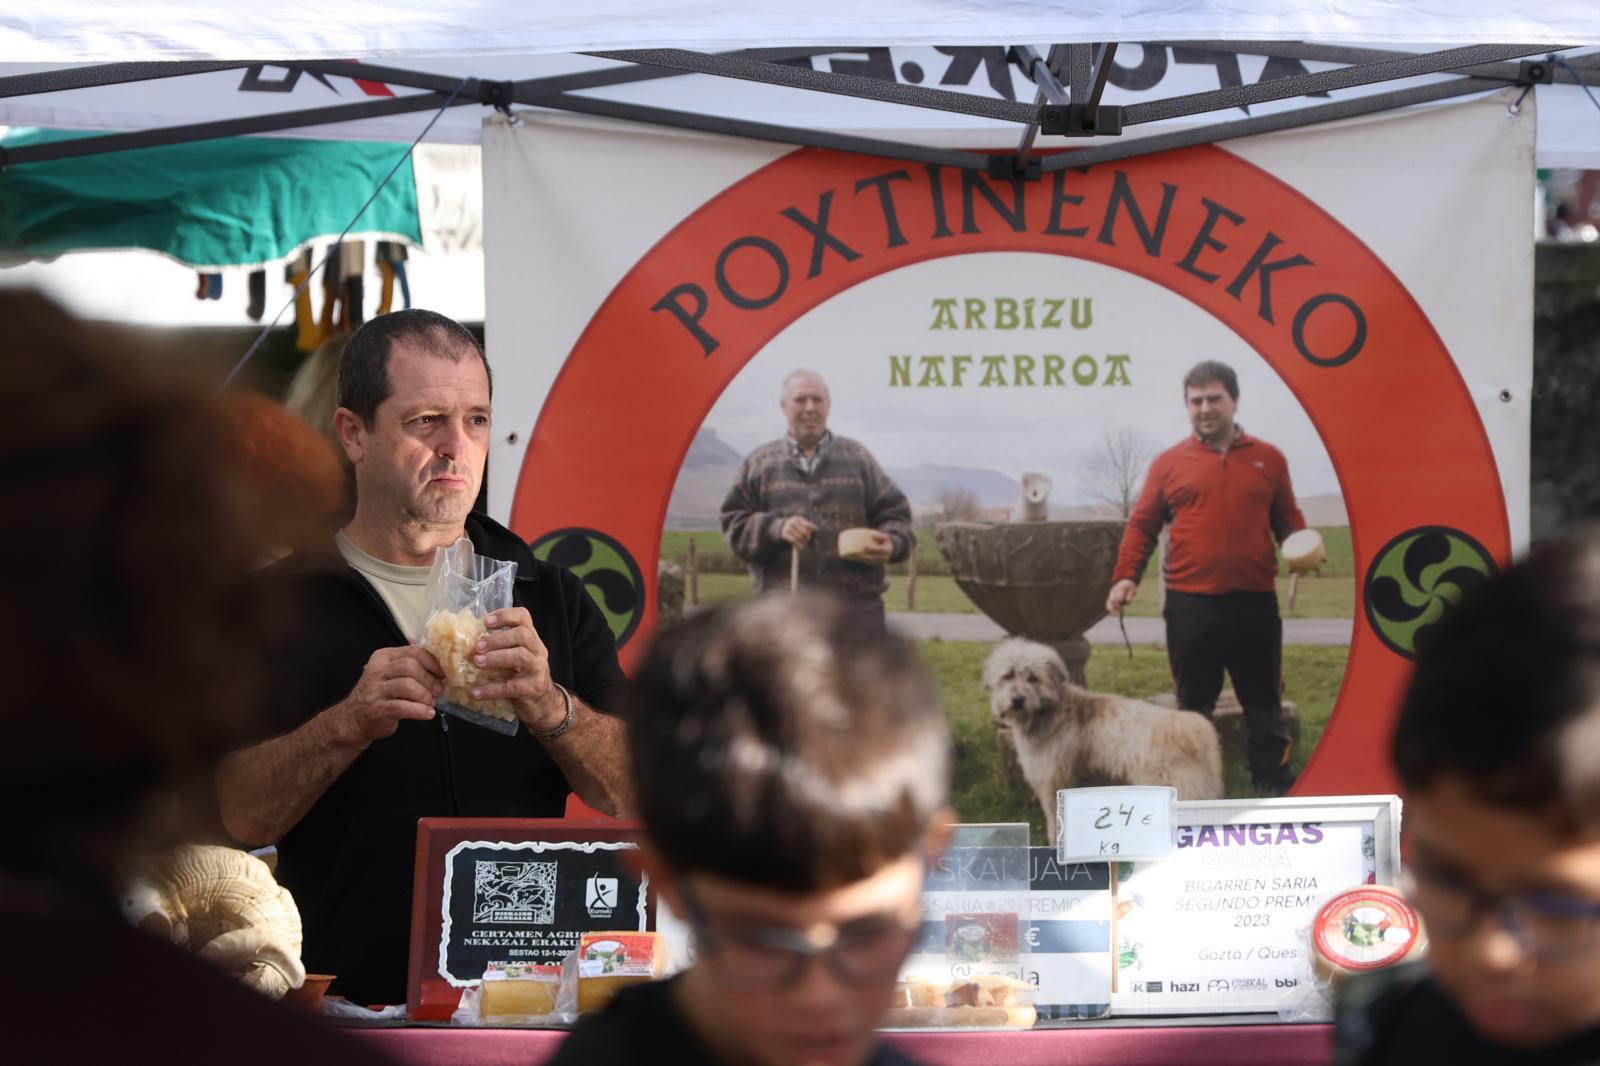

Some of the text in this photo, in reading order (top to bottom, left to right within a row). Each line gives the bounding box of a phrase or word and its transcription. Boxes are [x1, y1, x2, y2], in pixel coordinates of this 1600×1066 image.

[650, 163, 1368, 368] POXTINENEKO
[889, 354, 1133, 388] NAFARROA
[1094, 803, 1135, 830] 24
[927, 856, 1013, 881] SKAL
[1185, 877, 1318, 893] BIGARREN SARIA
[932, 898, 984, 912] SARIA
[1175, 897, 1260, 911] SEGUNDO
[1234, 914, 1271, 928] 2023
[472, 930, 543, 938] CERTAMEN
[464, 938, 528, 946] NEKAZAL
[1198, 949, 1242, 961] Gazta
